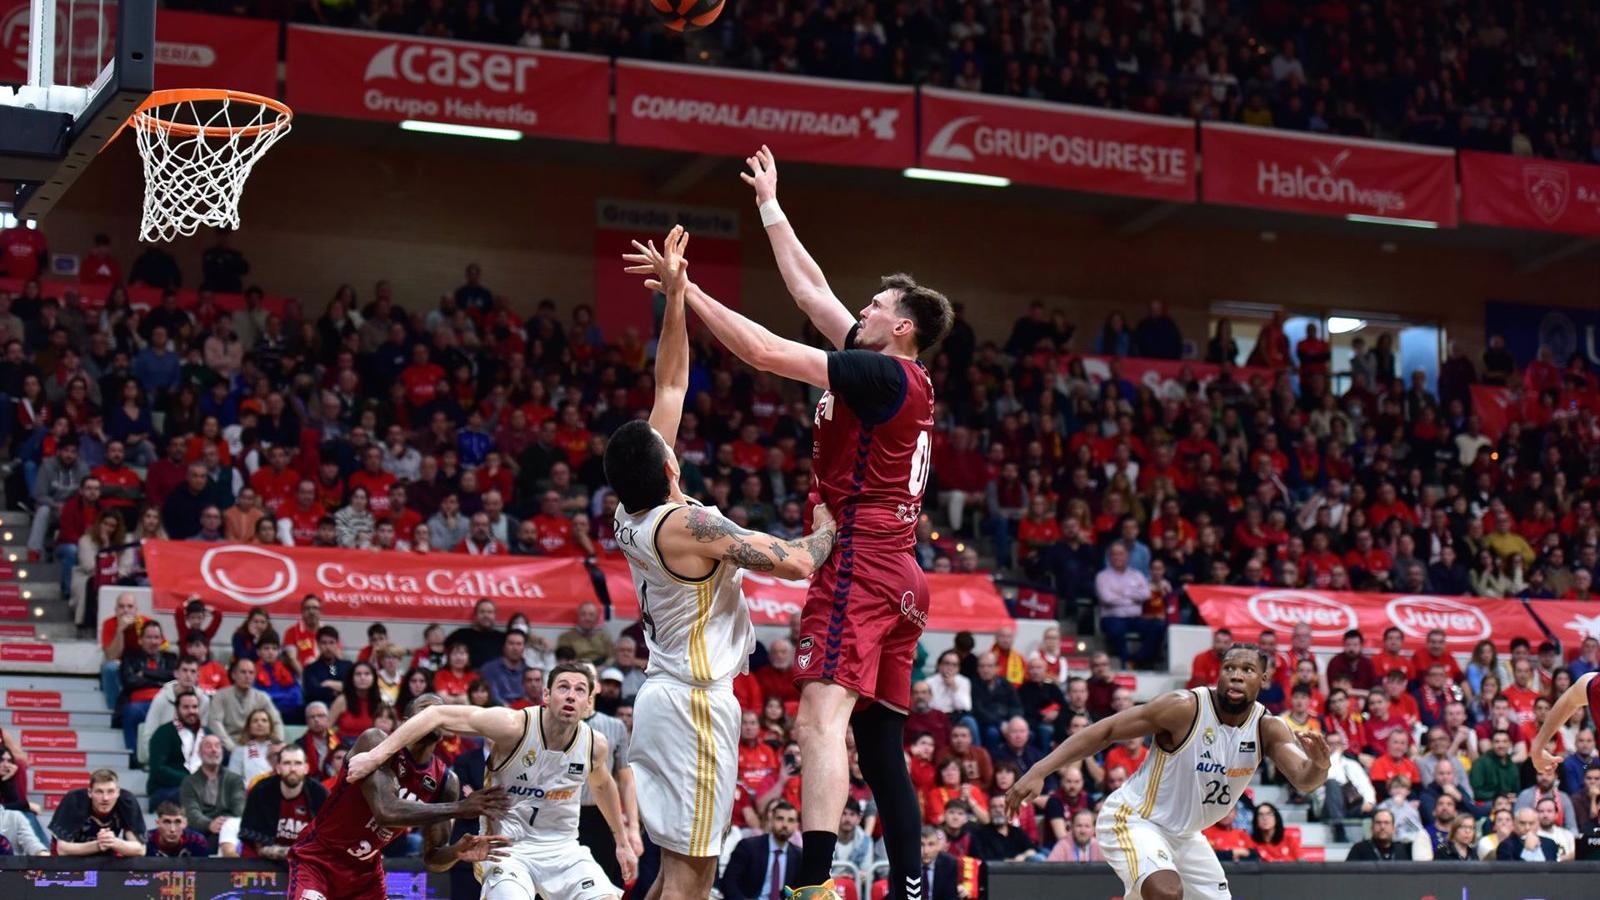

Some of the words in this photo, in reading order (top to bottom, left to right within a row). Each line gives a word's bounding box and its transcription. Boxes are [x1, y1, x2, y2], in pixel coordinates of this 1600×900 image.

[401, 45, 538, 93] caser
[364, 89, 438, 117] Grupo
[631, 95, 860, 137] COMPRALAENTRADA
[974, 126, 1186, 177] GRUPOSURESTE
[603, 205, 668, 227] Grada
[316, 562, 421, 593] Costa
[426, 568, 544, 599] Cálida
[745, 597, 801, 619] upo
[1264, 601, 1343, 625] Juver
[1404, 607, 1477, 630] Juver
[1202, 780, 1231, 805] 28
[529, 806, 539, 827] 1
